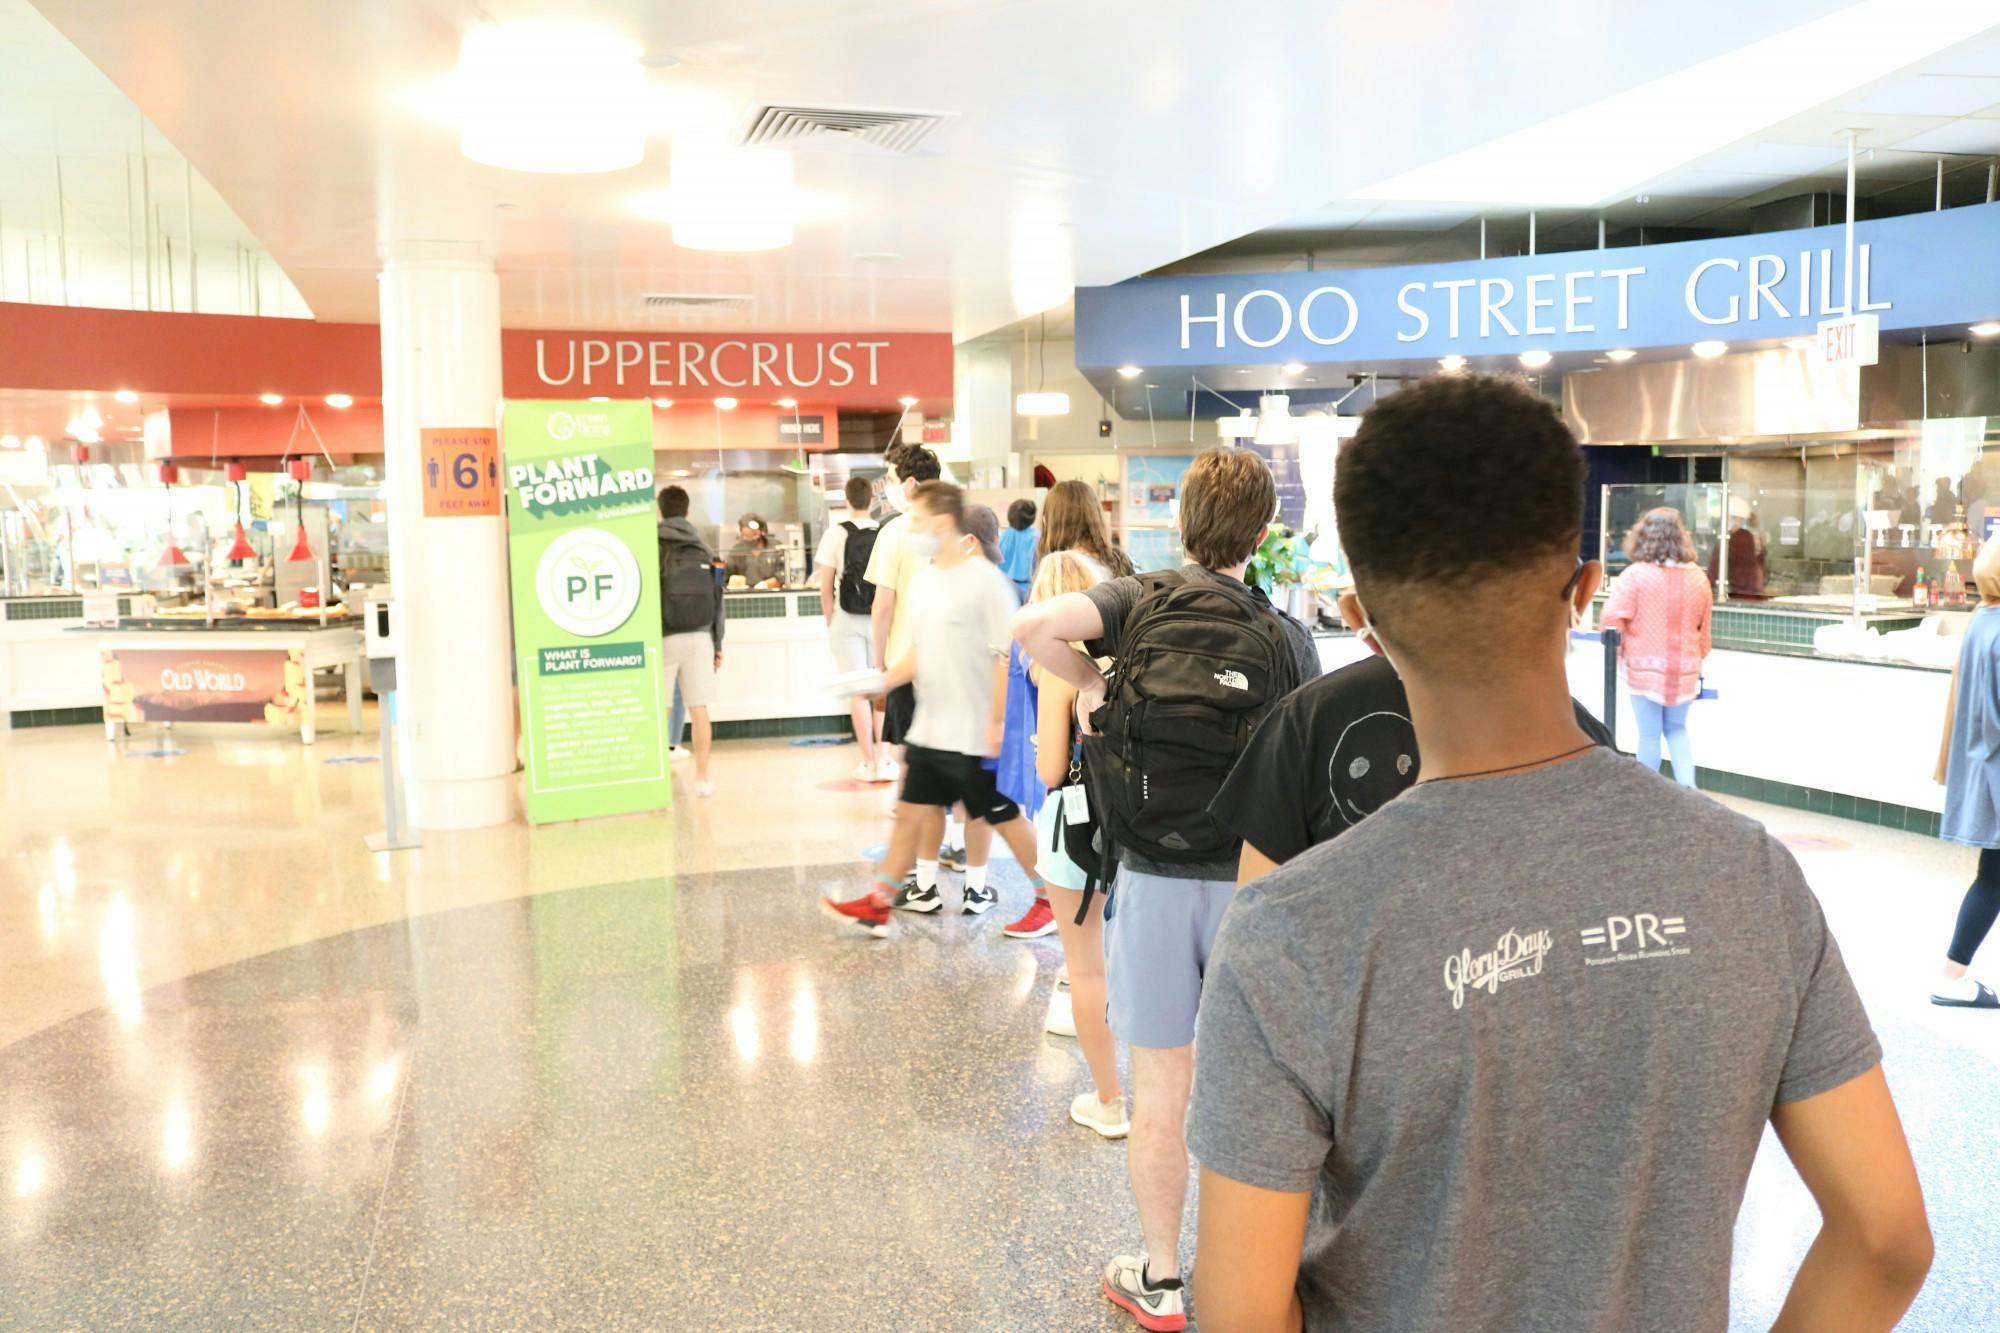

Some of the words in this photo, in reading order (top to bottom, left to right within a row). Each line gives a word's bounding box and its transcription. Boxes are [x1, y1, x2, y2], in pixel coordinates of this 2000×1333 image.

[1180, 285, 1359, 349] HOO
[1397, 266, 1647, 343] STREET
[1685, 243, 1893, 325] GRILL
[1826, 323, 1856, 362] EXIT
[535, 339, 890, 388] UPPERCRUST
[432, 437, 469, 445] PLEASE
[473, 437, 491, 445] STAY
[803, 422, 821, 434] HERE
[453, 453, 479, 490] 6
[509, 453, 598, 487] PLANT
[439, 500, 463, 508] FEET
[468, 499, 490, 508] AWAY
[518, 467, 654, 509] FORWARD
[567, 574, 614, 602] PF
[544, 649, 578, 661] WHAT
[580, 648, 591, 658] IS
[545, 660, 581, 672] PLANT
[583, 655, 642, 669] FORWARD?
[1444, 947, 1499, 1010] Glory
[1496, 926, 1554, 975] Days
[1499, 966, 1537, 983] GRILL
